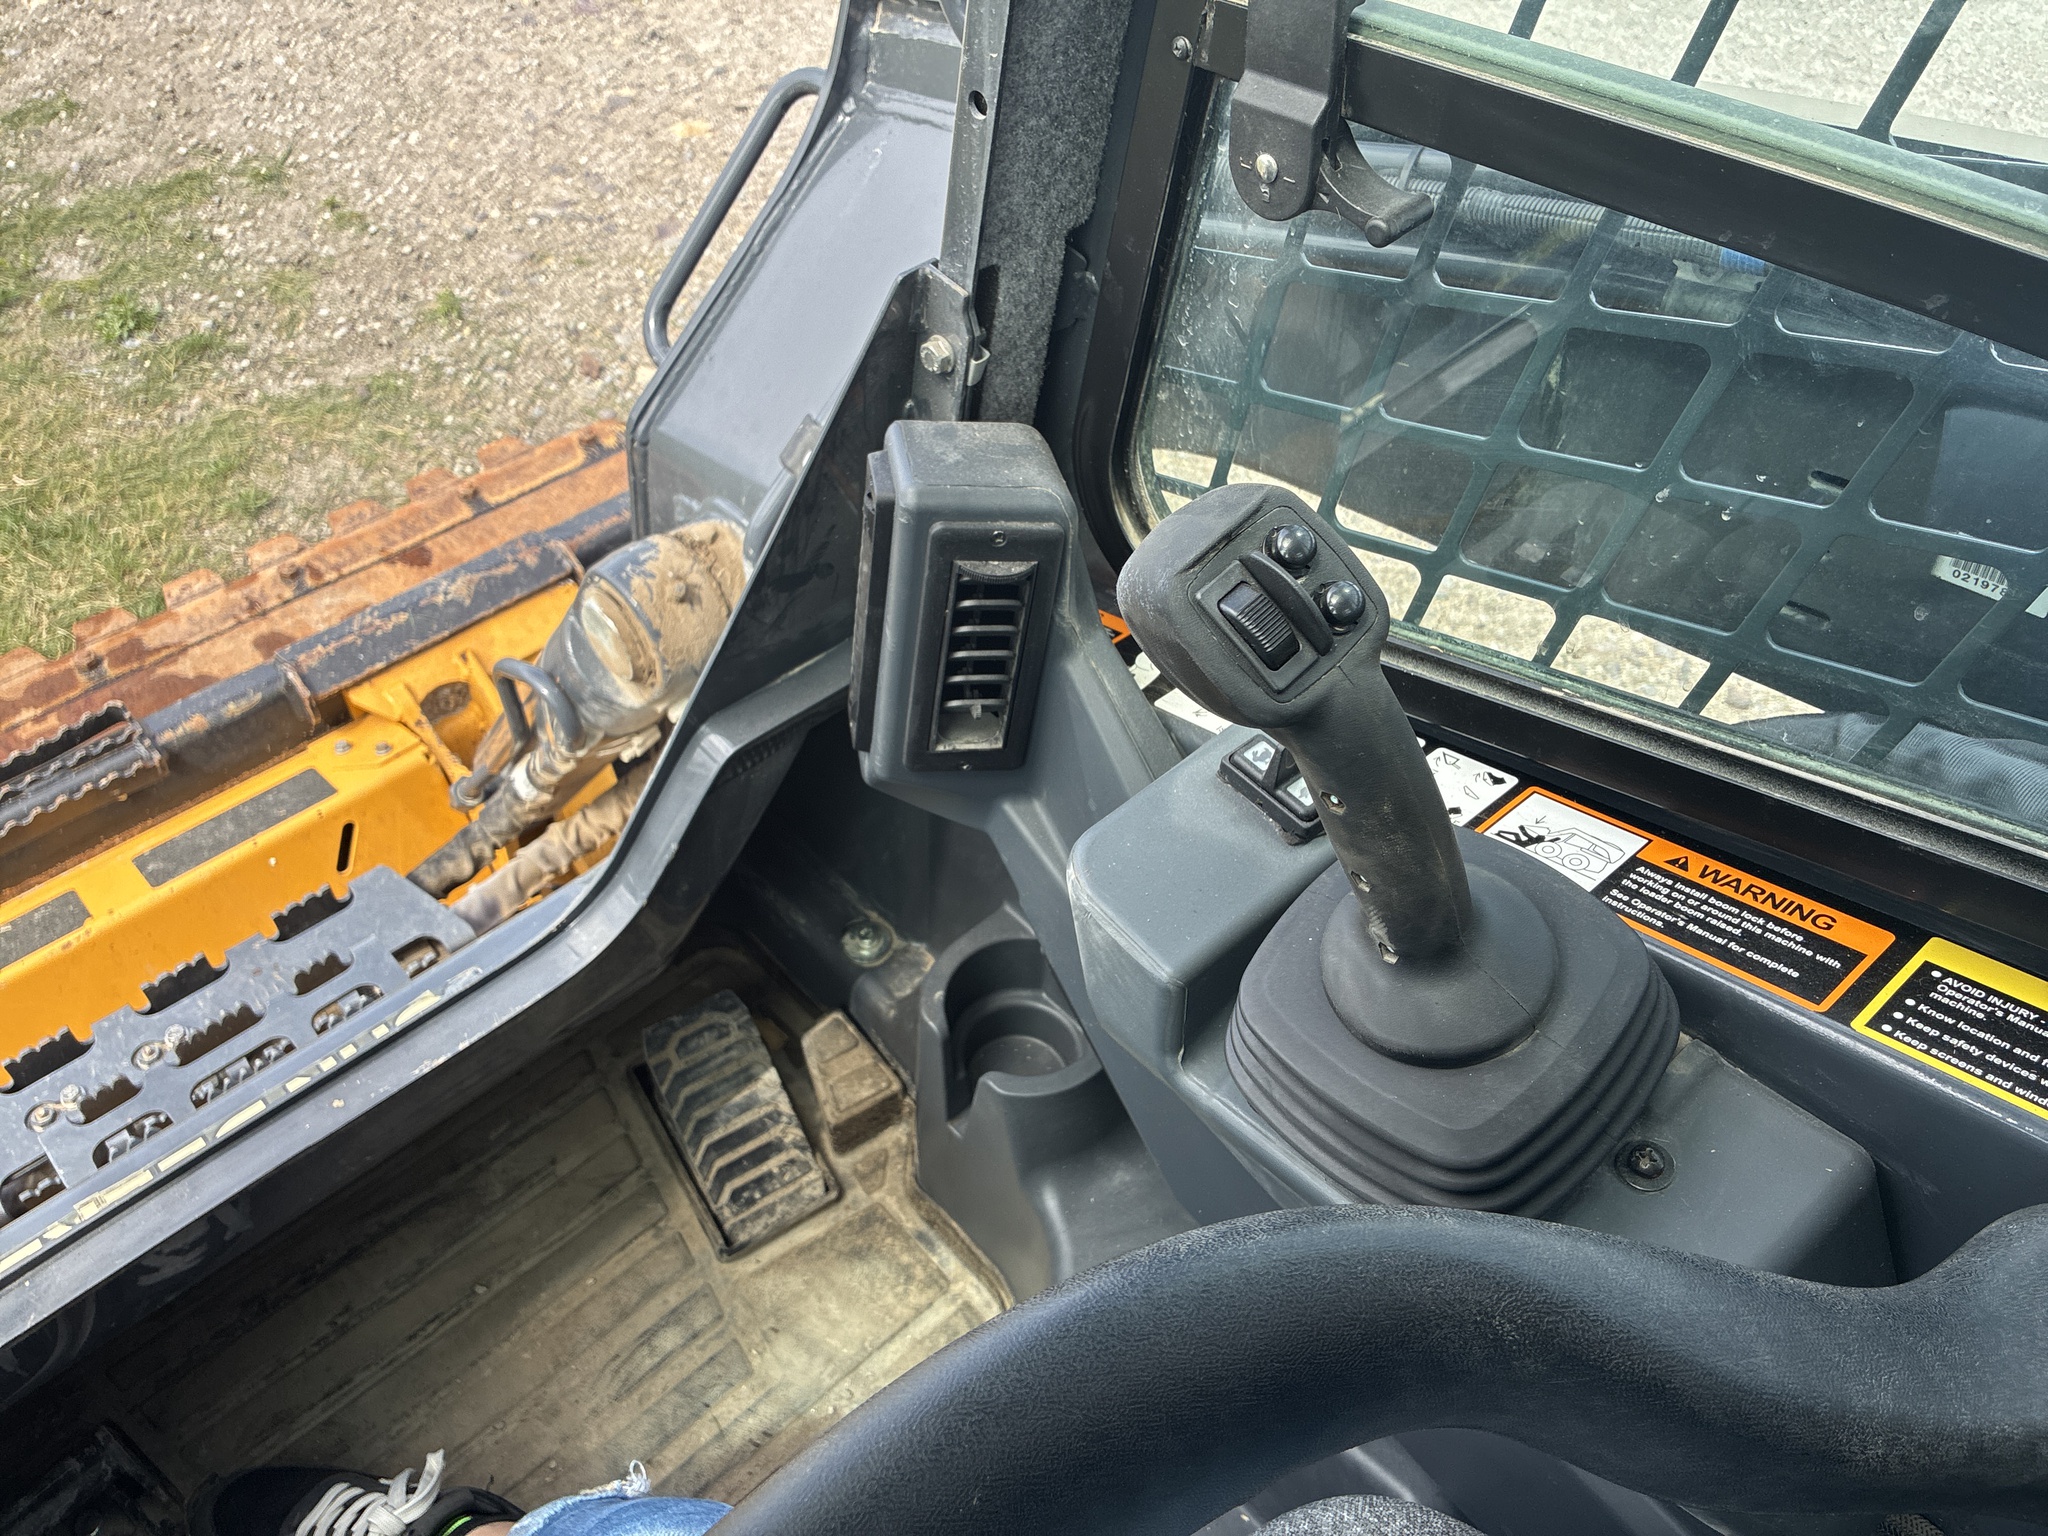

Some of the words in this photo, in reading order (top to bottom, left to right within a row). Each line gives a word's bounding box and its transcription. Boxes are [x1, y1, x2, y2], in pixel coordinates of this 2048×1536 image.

[1621, 879, 1638, 890] the
[1639, 887, 1673, 905] loader
[1673, 901, 1705, 919] boom
[1706, 915, 1742, 937] raised.
[1629, 873, 1670, 895] working
[1671, 891, 1686, 901] on
[1687, 898, 1700, 907] or
[1700, 904, 1742, 925] around
[1741, 921, 1762, 934] this
[1764, 931, 1814, 957] machine
[1815, 953, 1841, 969] with
[1636, 866, 1673, 886] Always
[1674, 881, 1708, 900] install
[1708, 896, 1740, 914] boom
[1741, 910, 1766, 926] lock
[1766, 922, 1804, 942] before
[1698, 864, 1837, 931] WARNING
[1609, 888, 1629, 901] See
[1631, 899, 1686, 927] Operator's
[1686, 923, 1728, 945] Manual
[1727, 941, 1746, 953] for
[1746, 950, 1800, 978] complete
[1929, 992, 1987, 1021] machine.
[1936, 984, 2005, 1017] Operator's
[1941, 977, 1986, 998] AVOID
[1987, 995, 2040, 1020] INJURY
[1905, 1017, 1941, 1037] Keep
[1941, 1034, 1984, 1057] safety
[1985, 1054, 2038, 1081] devices
[1917, 1003, 1957, 1025] Know
[1957, 1021, 2011, 1050] location
[2013, 1046, 2041, 1063] and
[1893, 1030, 1928, 1051] Keep
[1929, 1048, 1984, 1077] screens
[1985, 1073, 2013, 1090] and
[2014, 1086, 2048, 1108] wind
